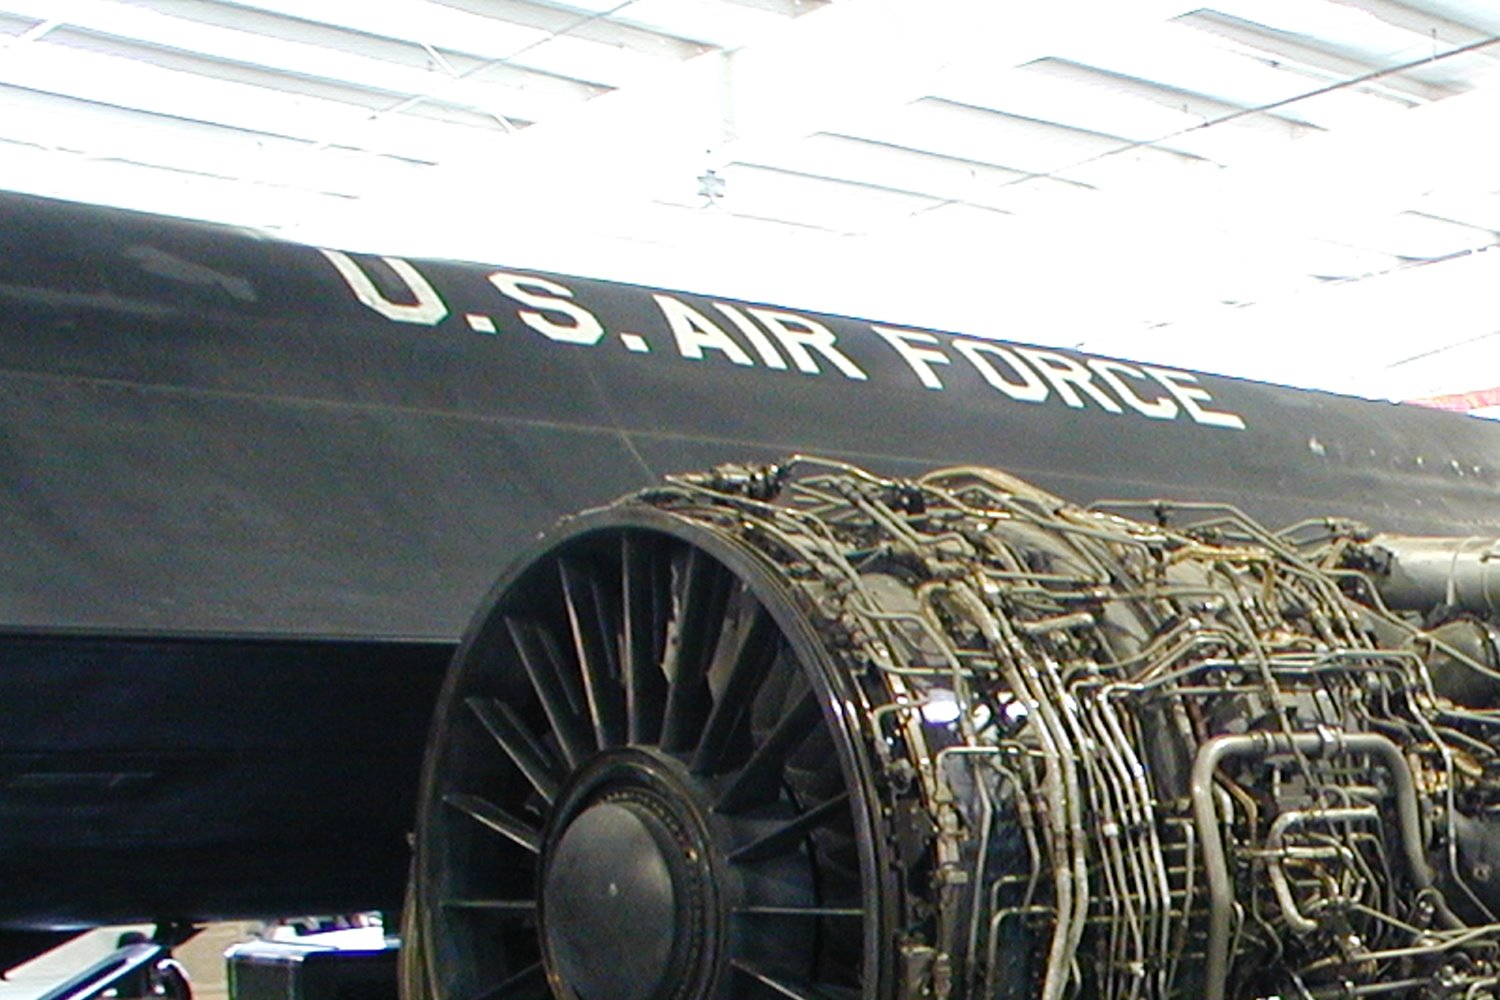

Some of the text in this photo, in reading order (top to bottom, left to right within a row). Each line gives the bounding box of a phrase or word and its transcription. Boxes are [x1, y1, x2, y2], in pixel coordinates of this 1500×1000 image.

[320, 248, 1245, 429] U.S. AIR FORCE
